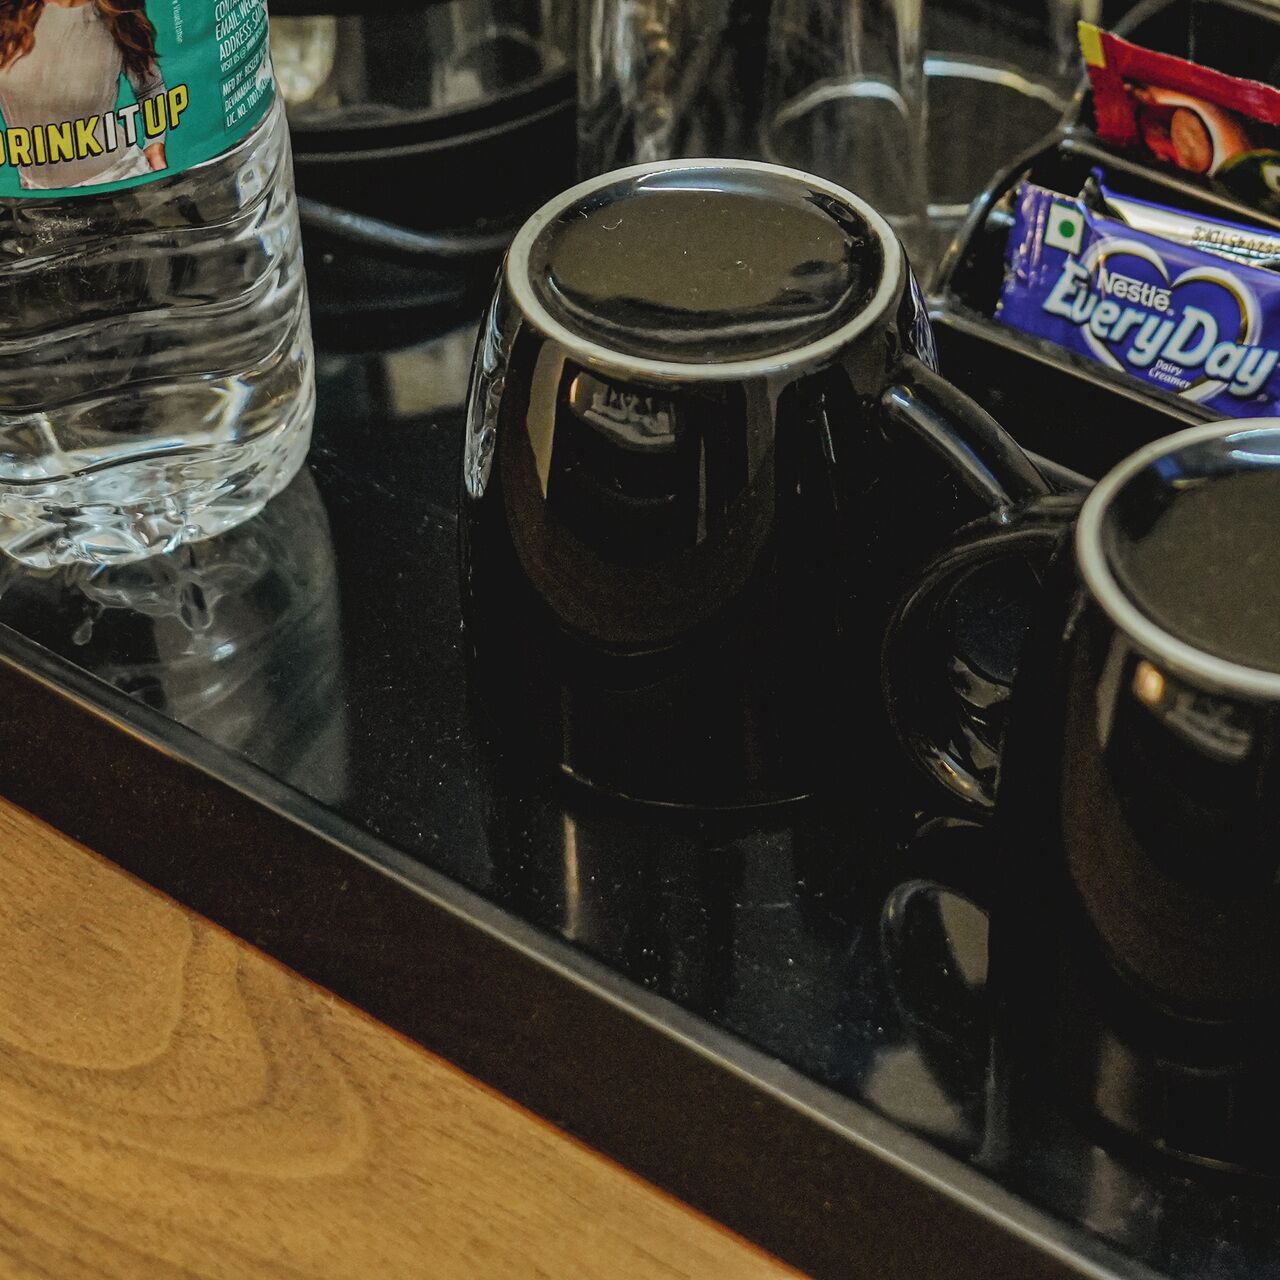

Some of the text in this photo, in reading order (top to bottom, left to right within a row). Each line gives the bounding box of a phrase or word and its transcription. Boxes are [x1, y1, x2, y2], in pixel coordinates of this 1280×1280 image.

[215, 6, 241, 40] EMAIL:
[219, 16, 253, 60] ADDRESS:
[1097, 268, 1172, 313] Nestlé
[1042, 254, 1280, 398] EveryDay
[1148, 367, 1192, 389] Creamer
[1155, 359, 1183, 377] Dairy
